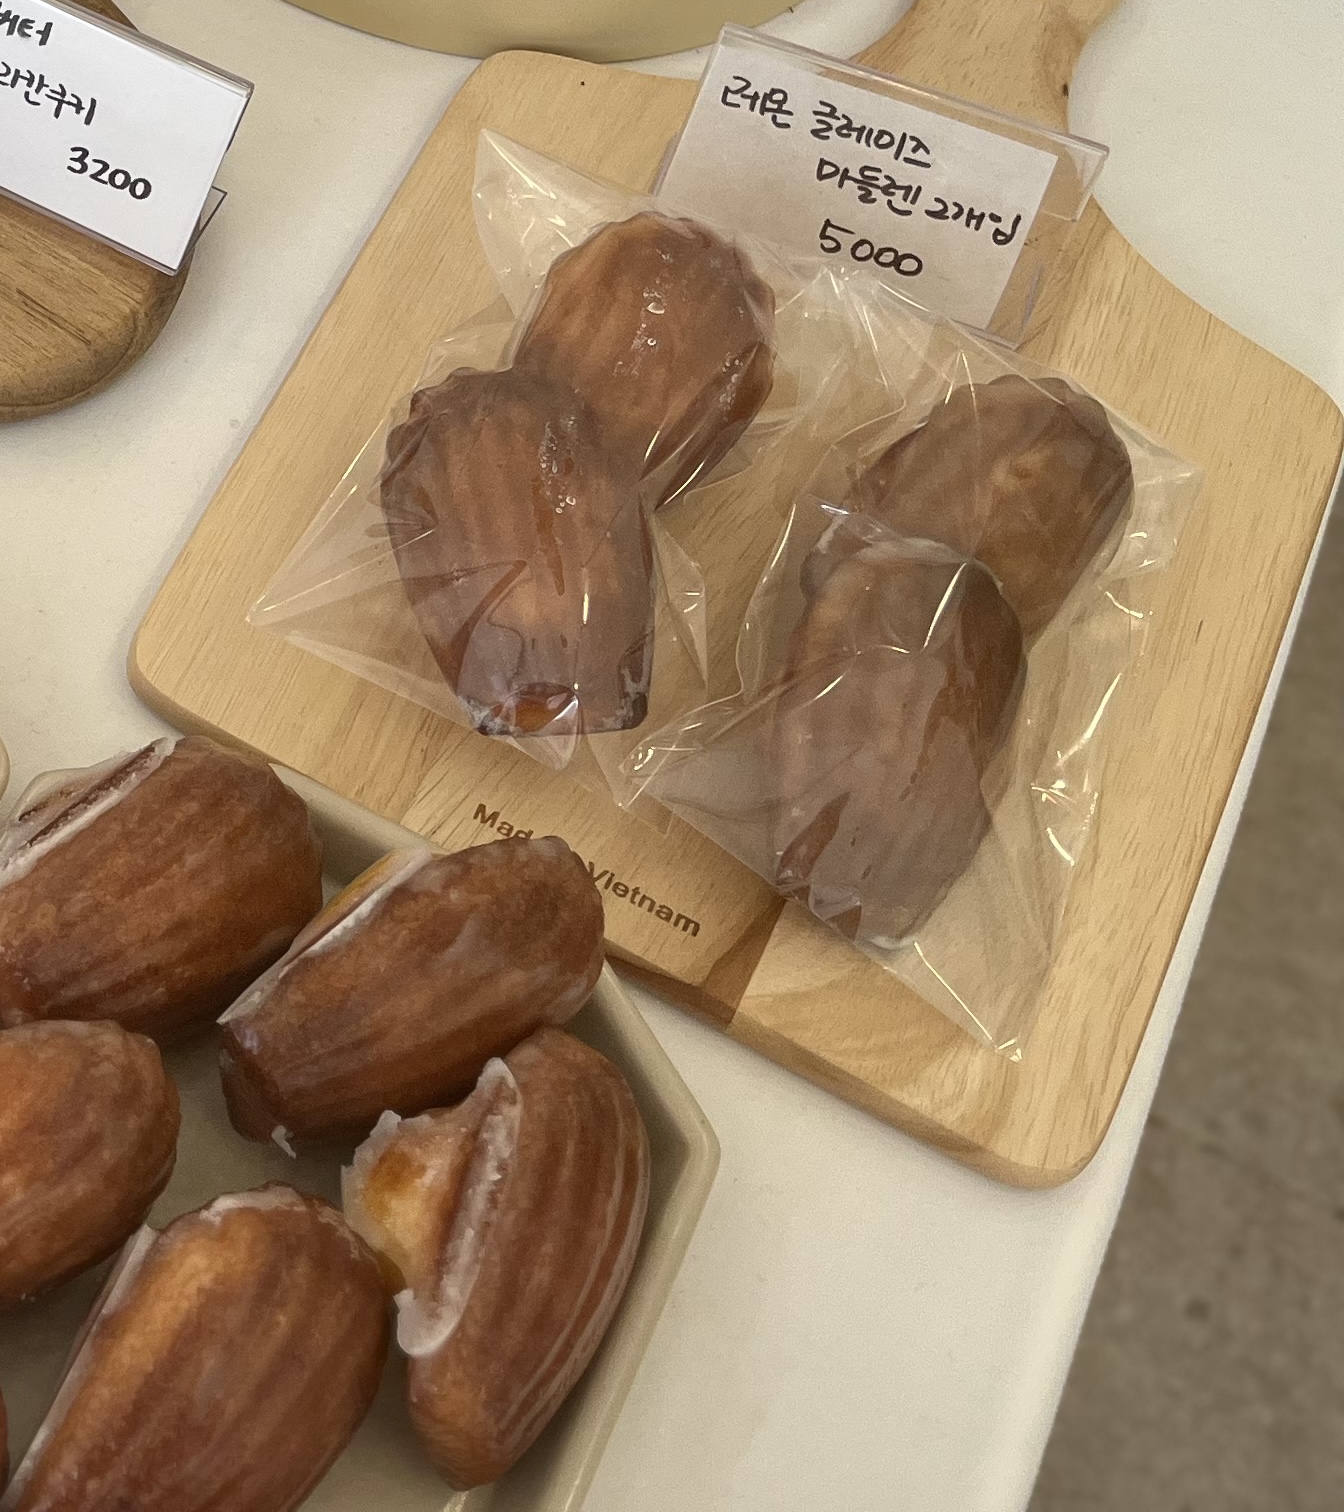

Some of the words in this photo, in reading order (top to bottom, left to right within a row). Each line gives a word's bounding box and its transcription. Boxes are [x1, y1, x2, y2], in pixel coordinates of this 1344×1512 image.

[721, 75, 794, 128] 레몬
[810, 100, 931, 169] 글레이즈
[67, 146, 152, 200] 3200
[816, 158, 922, 216] 마들렌
[819, 219, 924, 276] 5000
[473, 803, 534, 840] Mad
[587, 861, 701, 937] Vietnam
